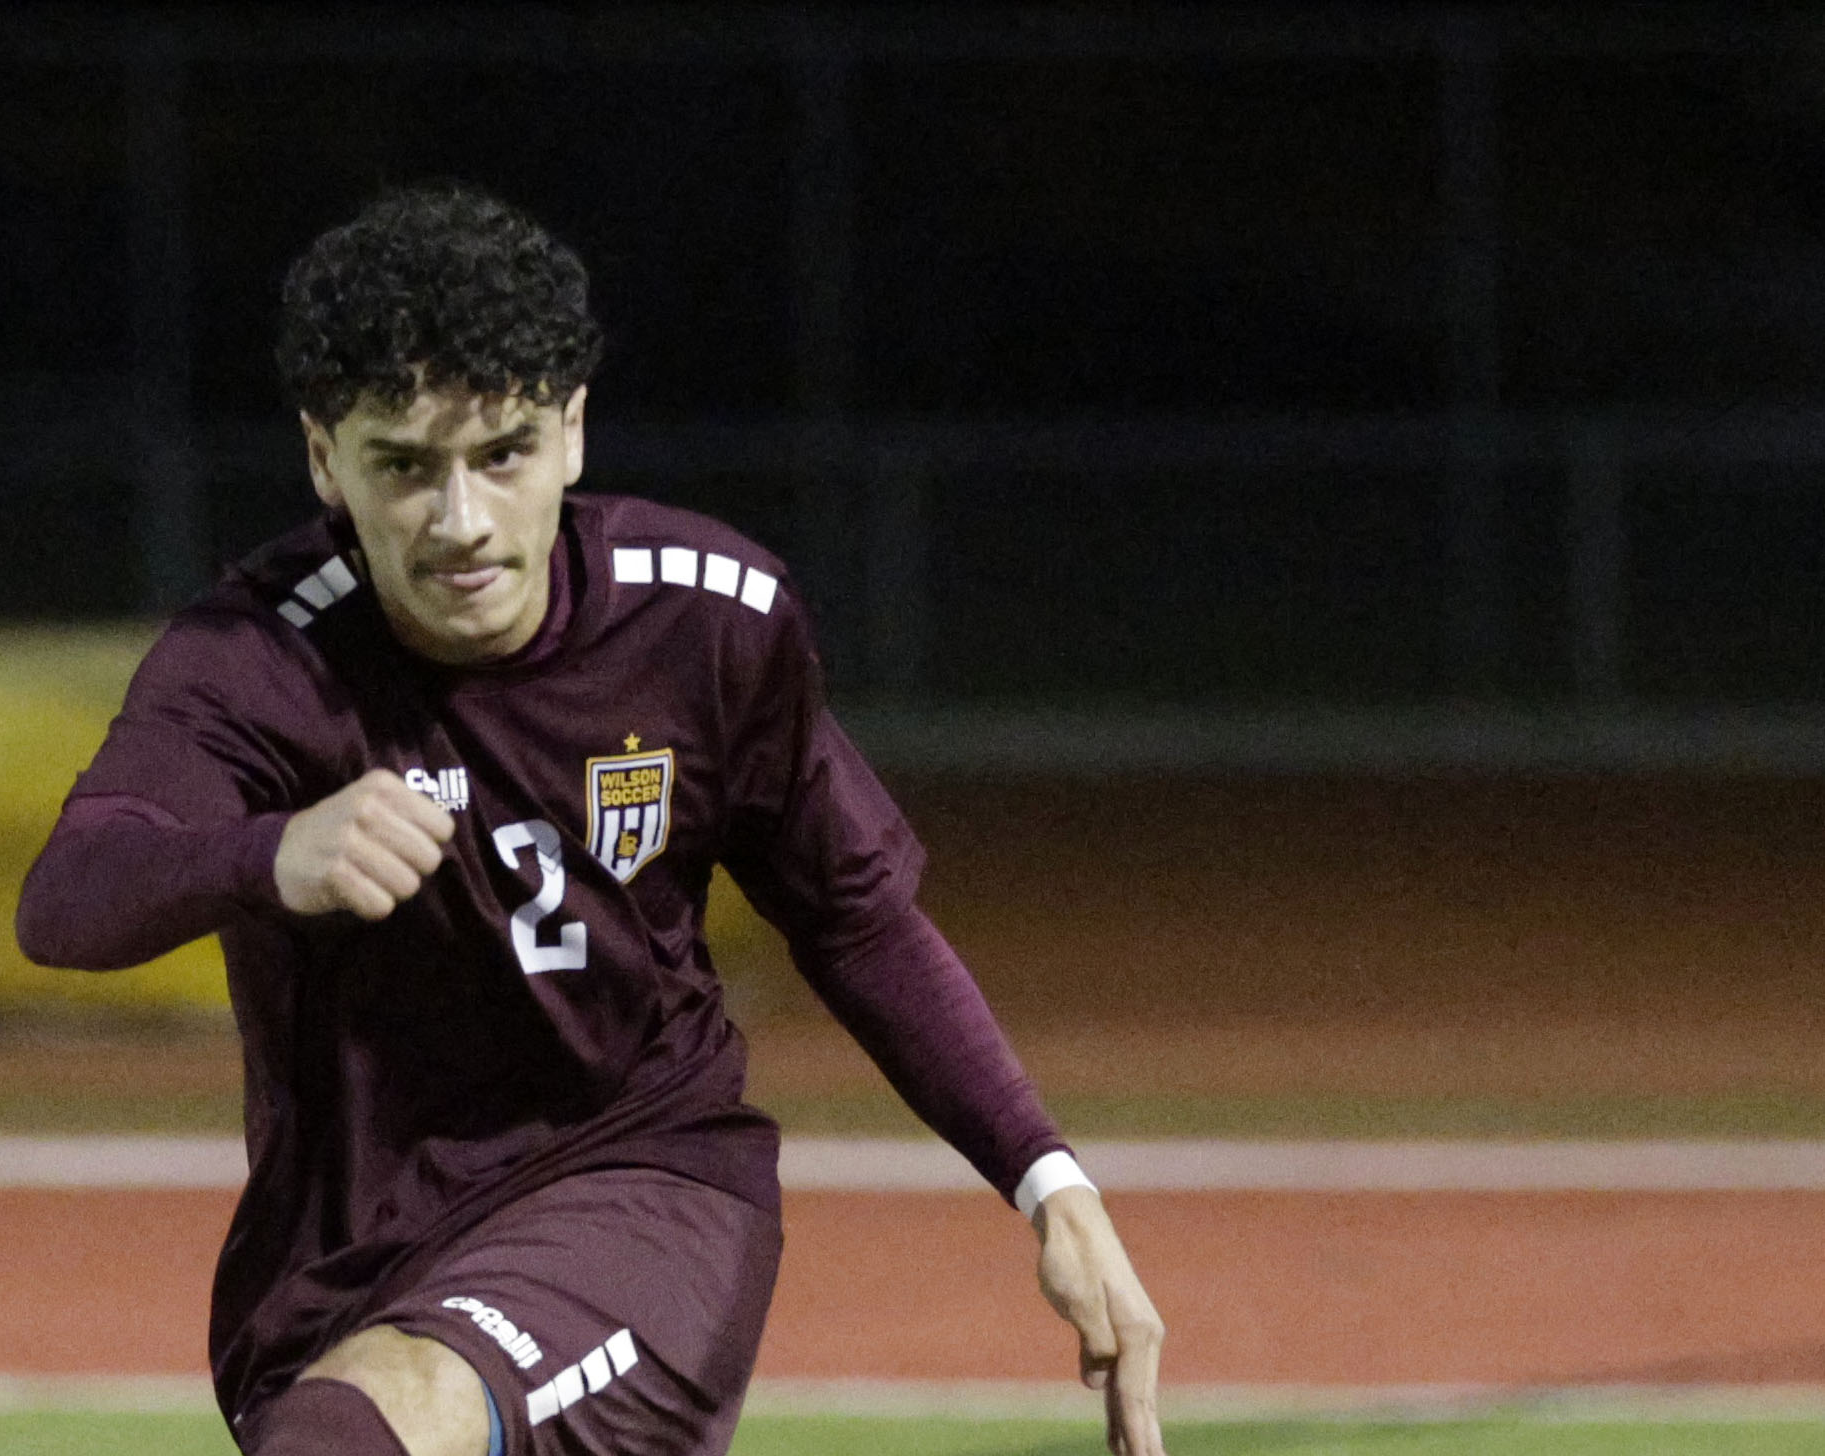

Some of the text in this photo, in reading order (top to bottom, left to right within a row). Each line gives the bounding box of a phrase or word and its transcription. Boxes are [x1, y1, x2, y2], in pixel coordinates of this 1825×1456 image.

[600, 767, 661, 789] WILSON
[601, 784, 661, 807] SOCCER
[492, 818, 587, 975] 2
